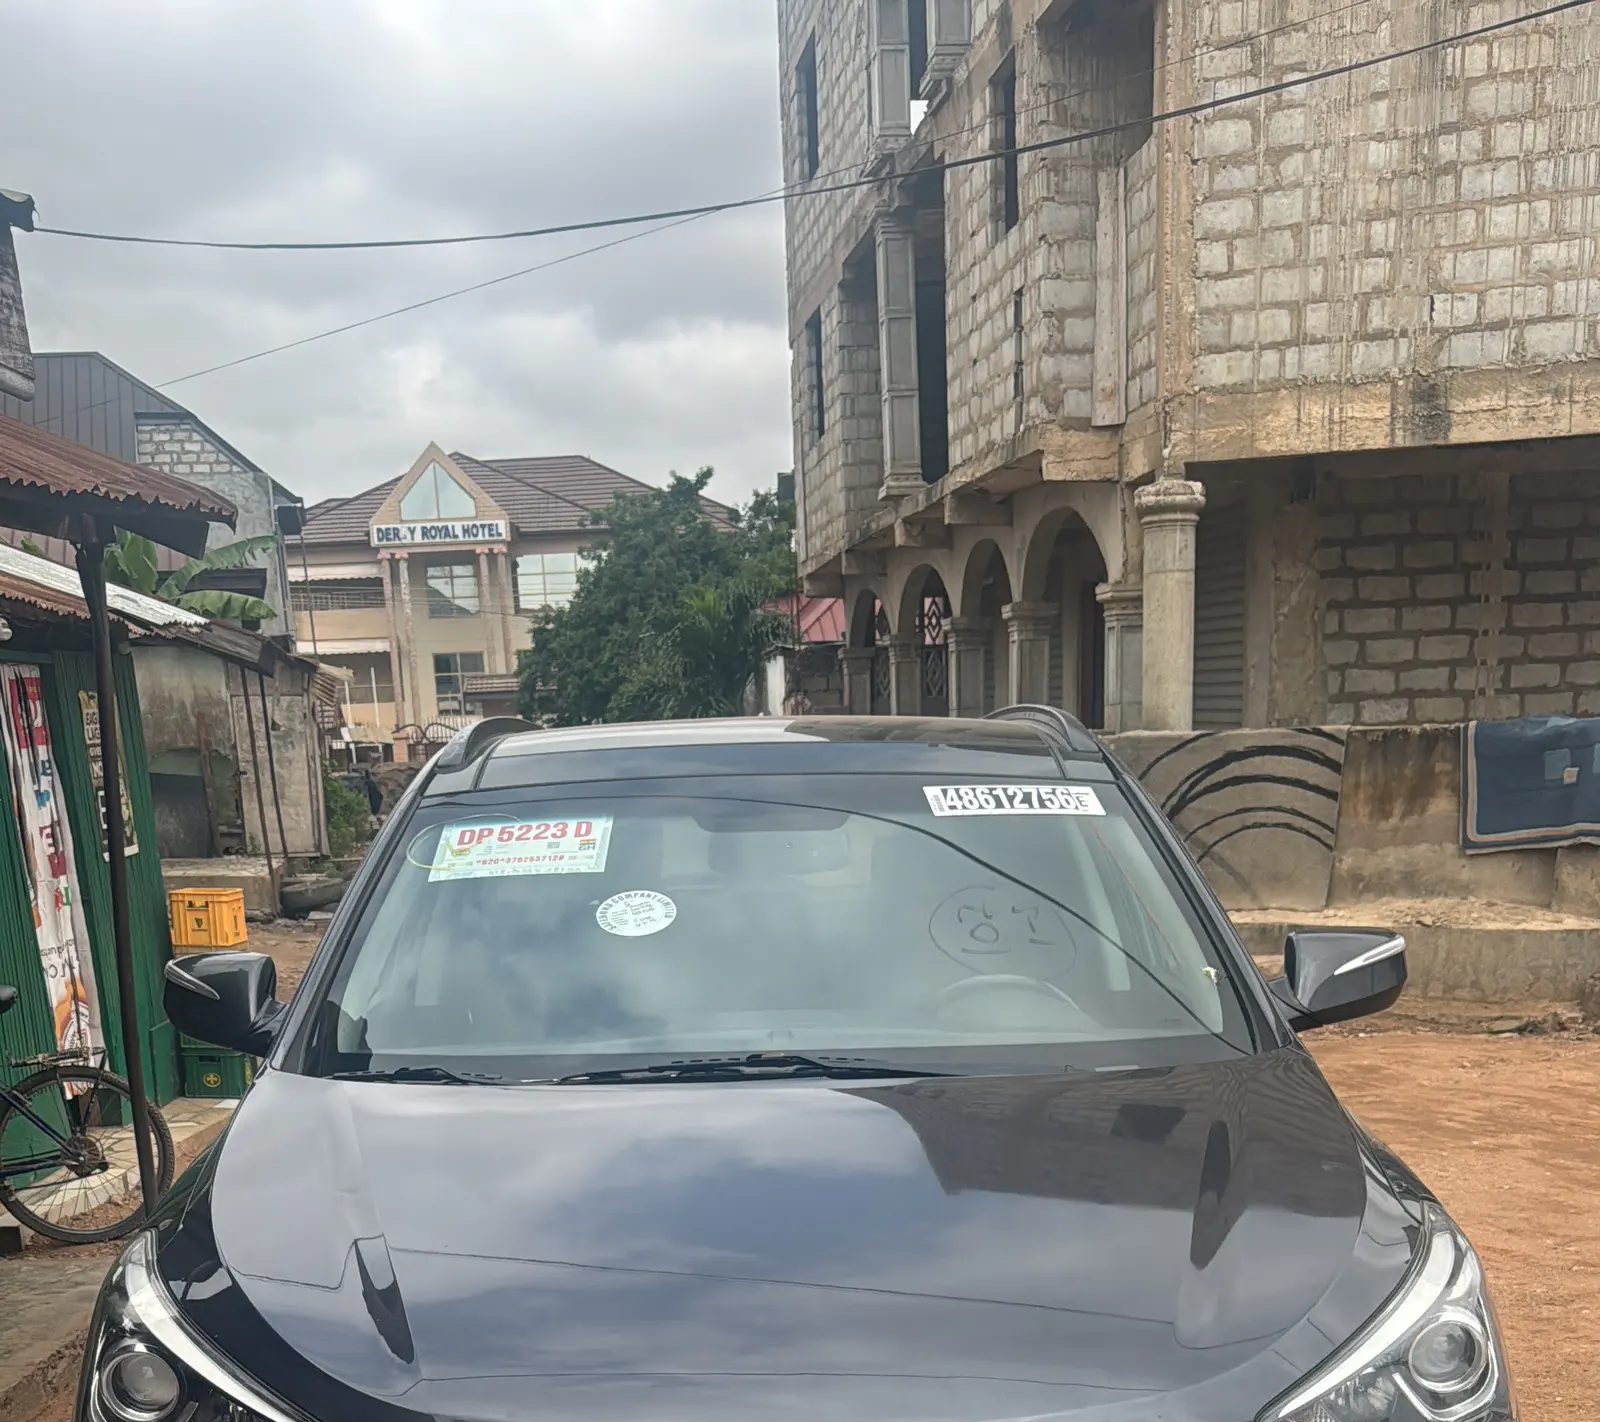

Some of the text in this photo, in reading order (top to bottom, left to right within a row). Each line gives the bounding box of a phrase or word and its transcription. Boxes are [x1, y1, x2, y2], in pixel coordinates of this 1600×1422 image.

[376, 522, 503, 543] DERY ROYAL HOTEL
[945, 786, 1079, 811] 48612756
[457, 820, 593, 846] DP 5223 D
[611, 892, 658, 904] COMPANY
[657, 896, 675, 919] LIMITED
